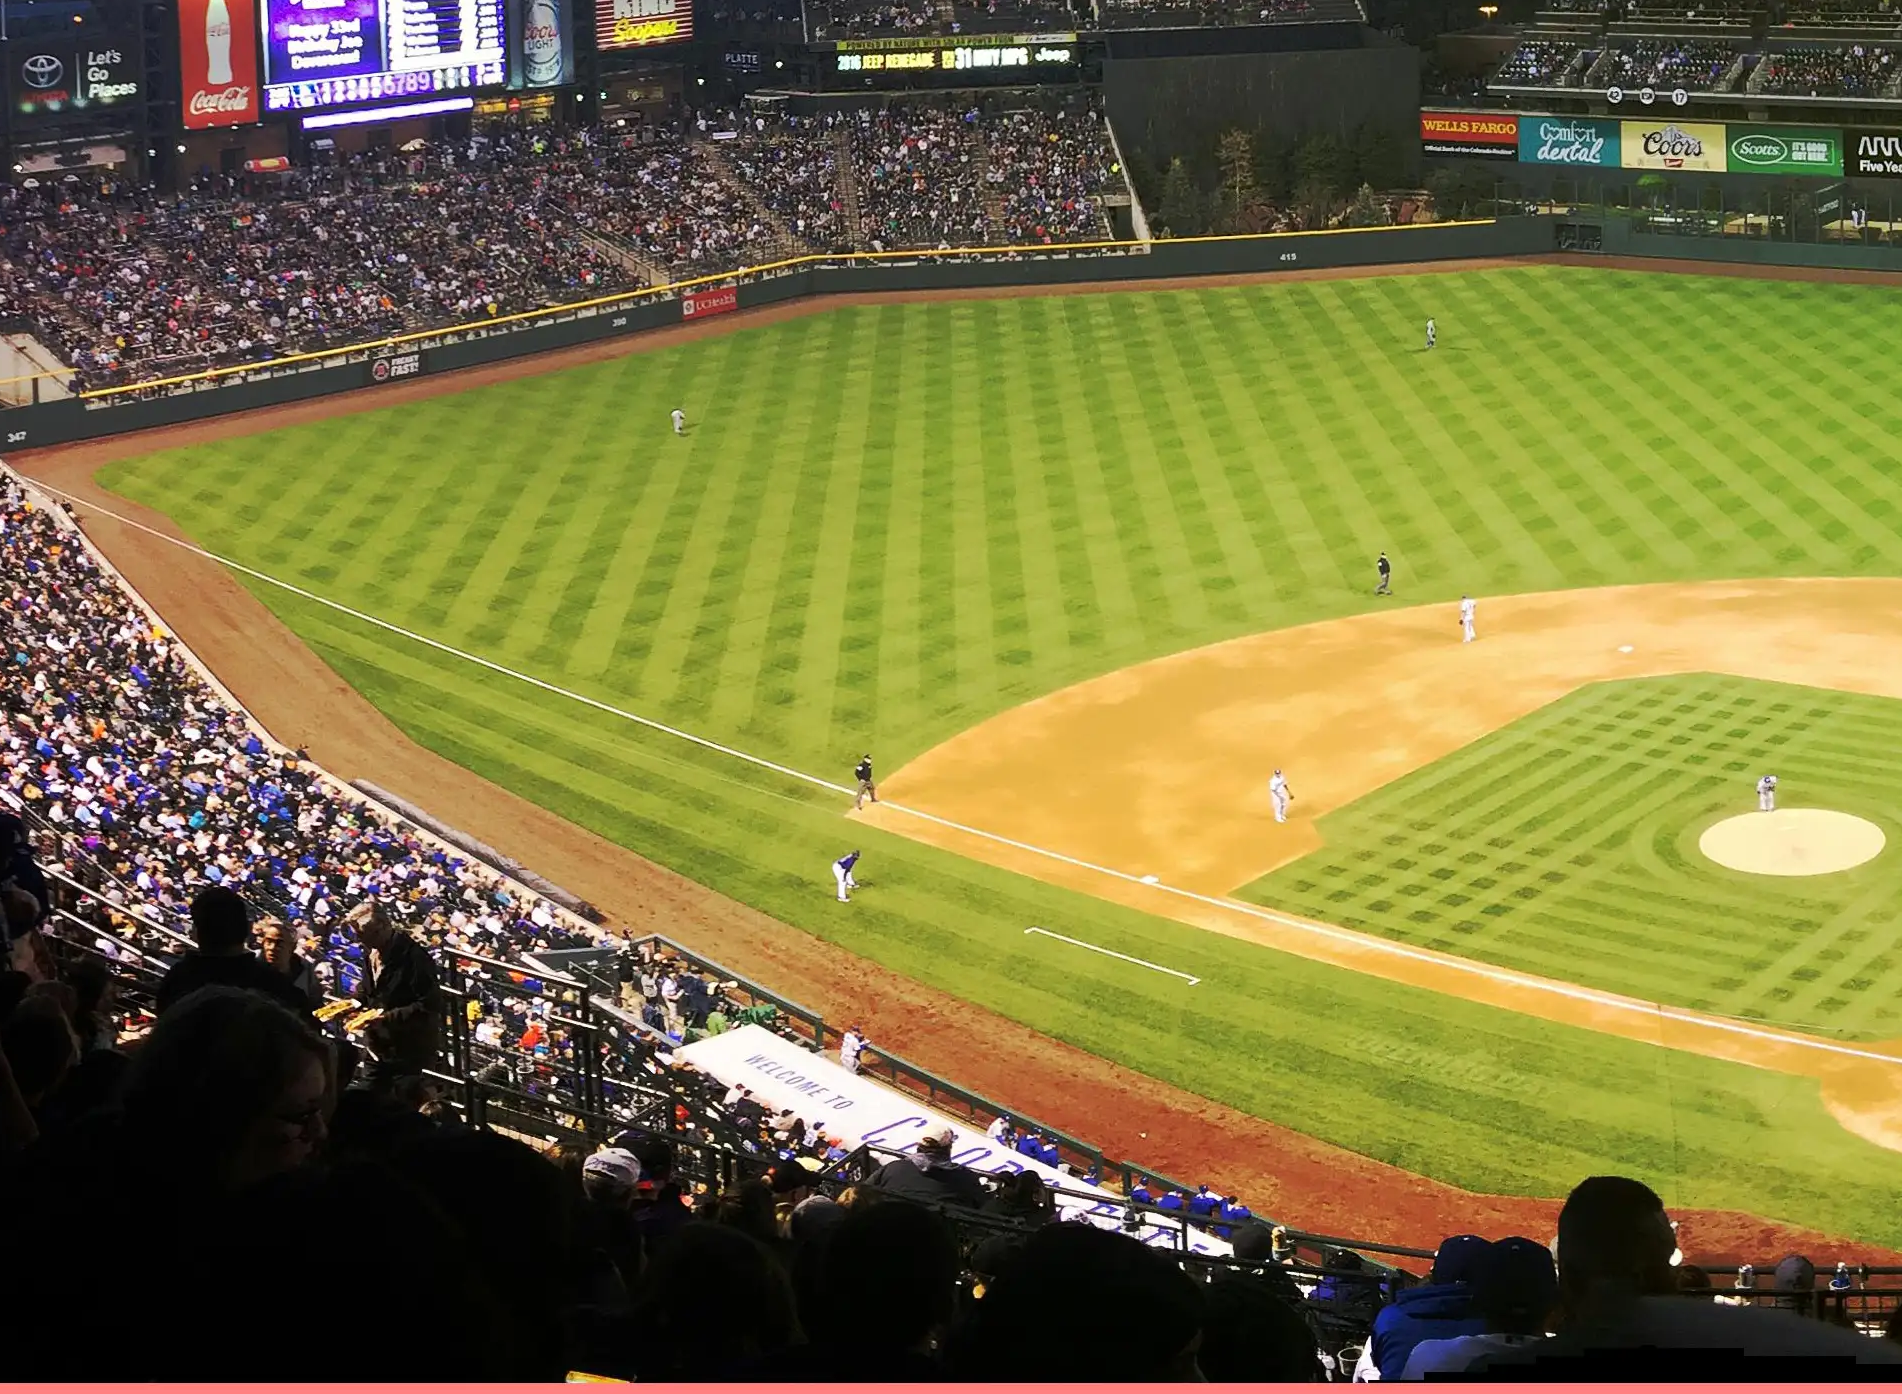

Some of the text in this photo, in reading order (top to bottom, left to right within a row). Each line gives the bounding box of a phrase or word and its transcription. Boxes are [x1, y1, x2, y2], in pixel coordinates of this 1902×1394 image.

[847, 40, 879, 49] POWERED
[88, 49, 122, 66] Let's
[837, 53, 935, 70] 2016 JEEP RENEGADE
[1035, 47, 1071, 63] Jeep
[88, 67, 109, 82] Go
[88, 81, 137, 99] Places
[1422, 119, 1517, 135] WELLS FARGO
[1539, 120, 1596, 143] Comfort
[1641, 130, 1704, 157] Coors
[1859, 159, 1883, 172] Five
[1279, 252, 1297, 261] 415
[390, 362, 419, 377] FAST!
[7, 431, 27, 443] 347
[743, 1053, 855, 1111] WELCOME TO
